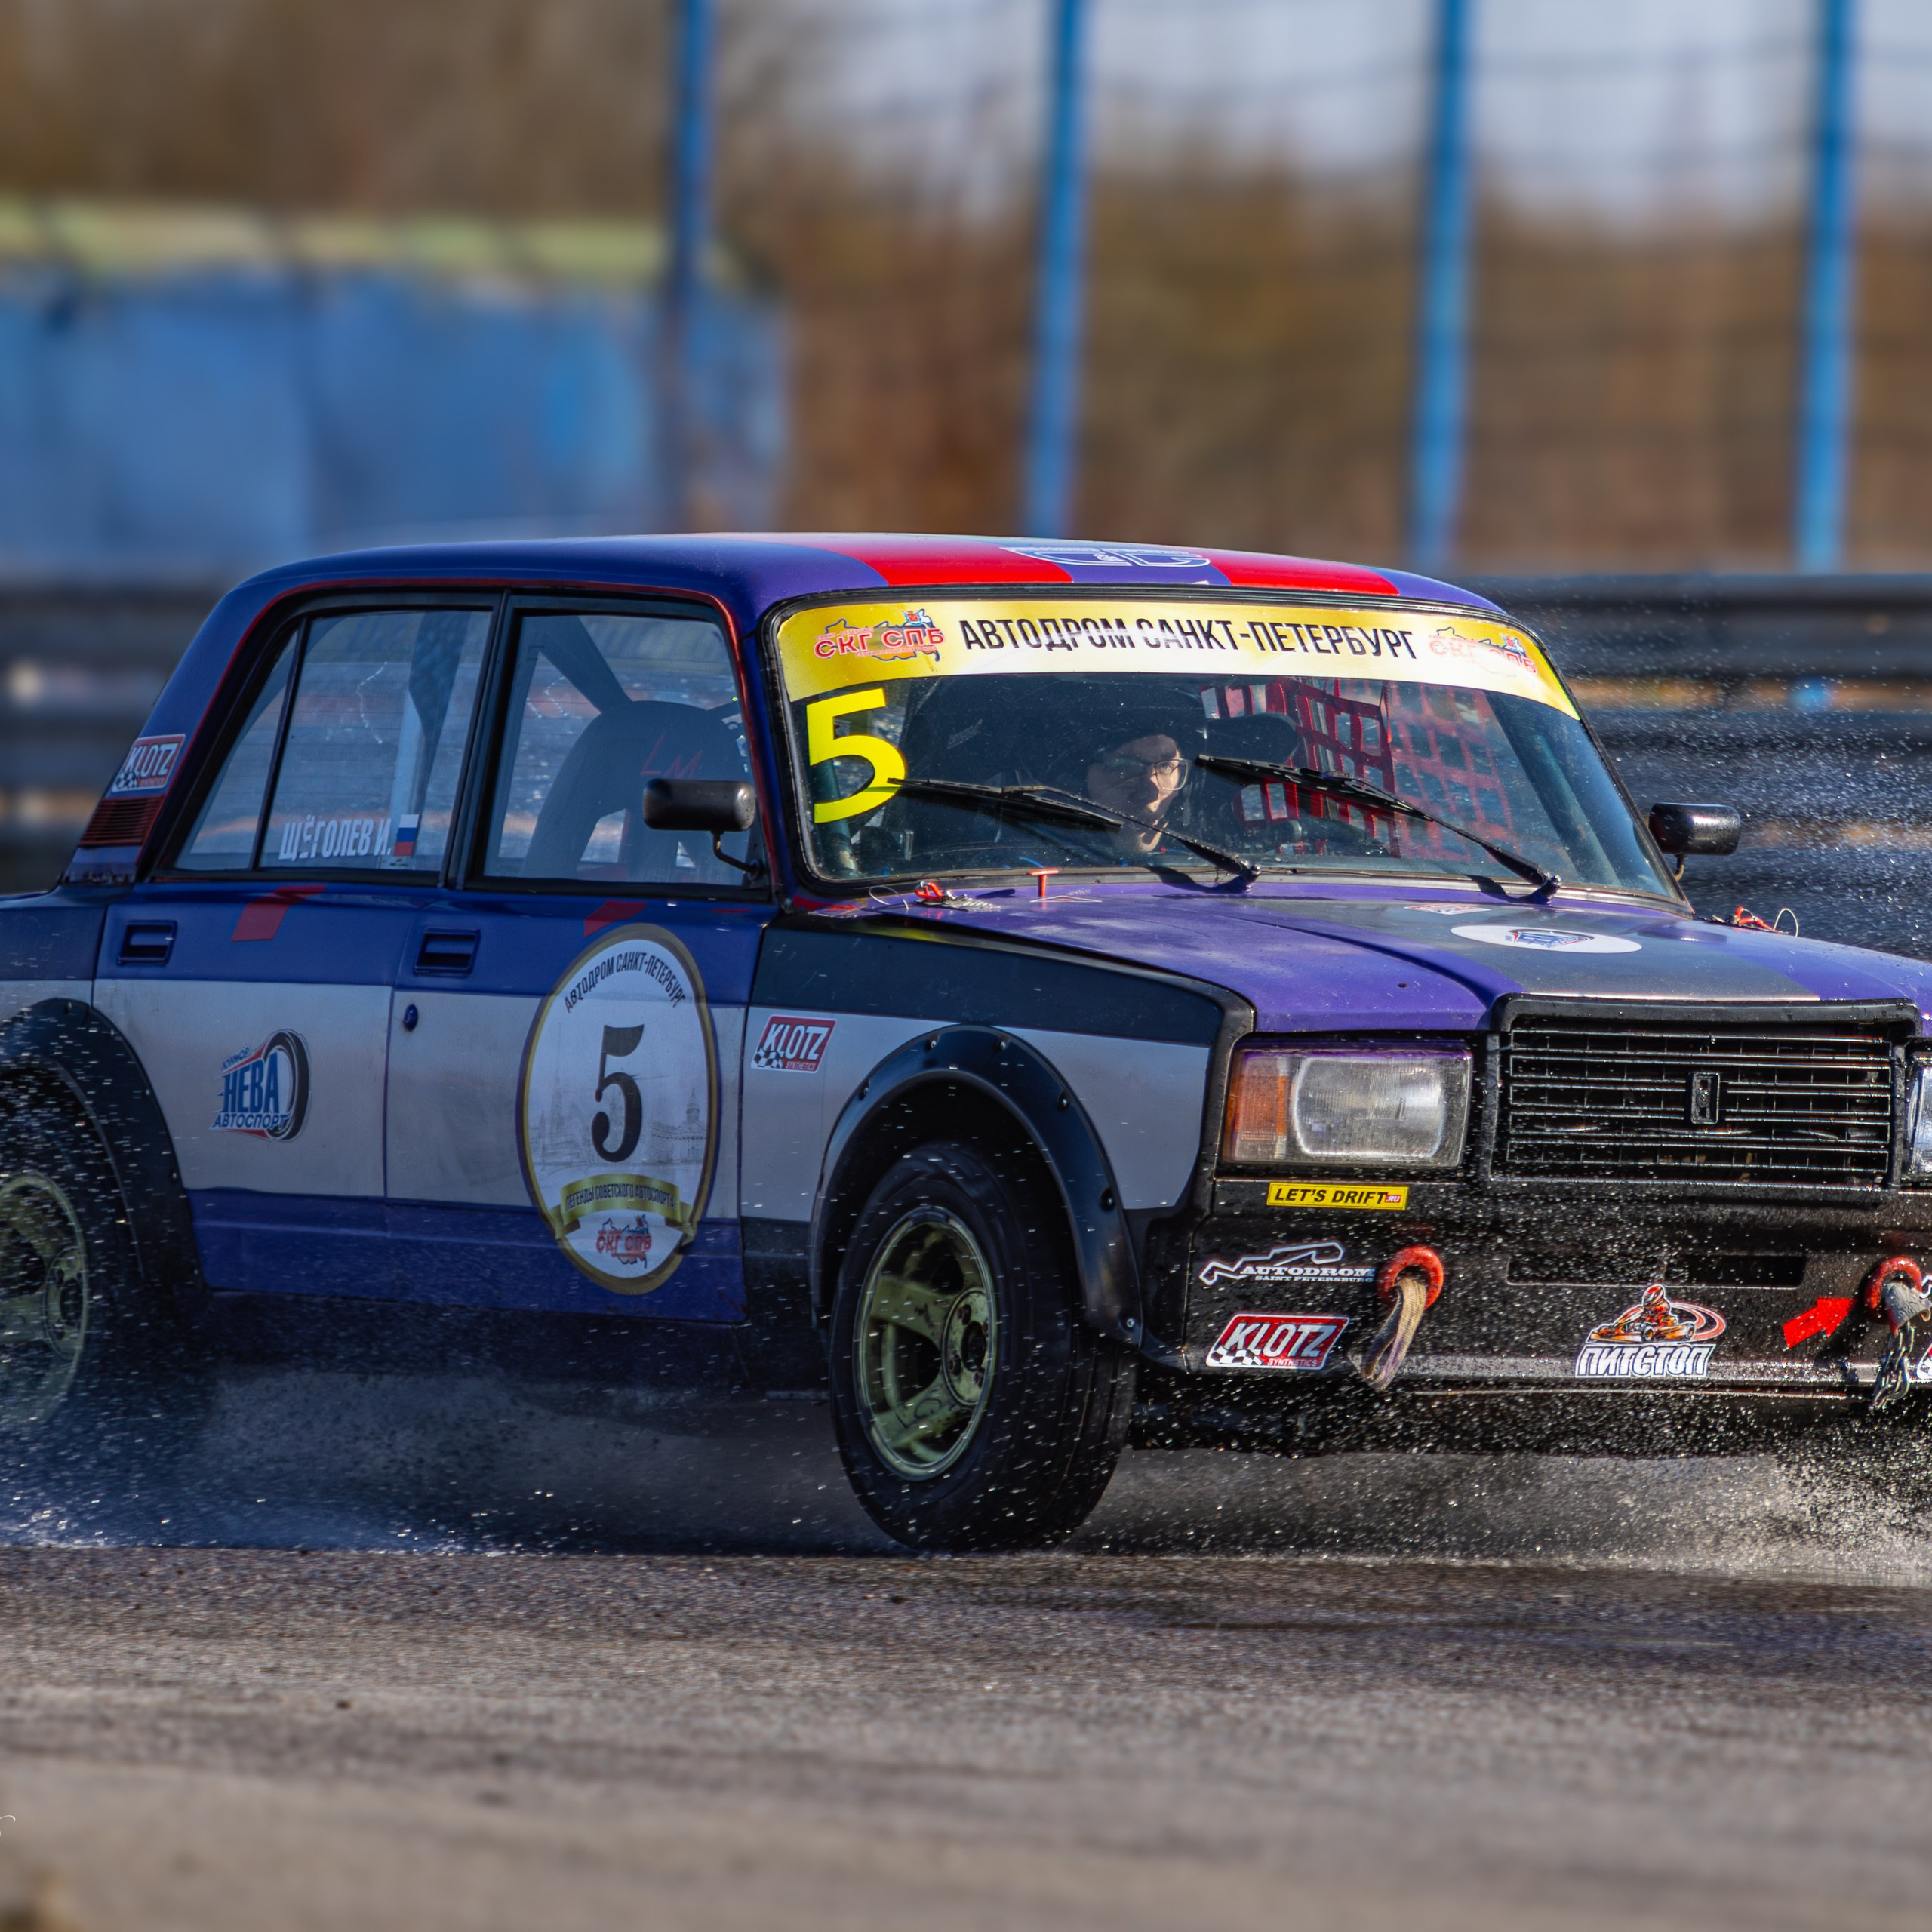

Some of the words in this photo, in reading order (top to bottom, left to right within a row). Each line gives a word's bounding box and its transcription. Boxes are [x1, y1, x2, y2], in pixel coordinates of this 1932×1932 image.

[814, 633, 872, 659] СКГ
[881, 628, 945, 649] СПБ
[959, 618, 1136, 652] АВТОДРОМ
[1137, 618, 1417, 659] САНКТ-ПЕТЕРБУРГ
[124, 743, 179, 778] KLOTZ
[806, 688, 907, 824] 5
[564, 956, 614, 1013] АВТОДРОМ
[616, 952, 686, 1008] САНКТ-ПЕТЕРБУРГ
[762, 1023, 830, 1060] KLOTZ
[222, 1051, 280, 1113] НЕВА
[591, 1024, 645, 1163] 5
[212, 1113, 291, 1129] АВТОСПОРТ
[566, 1186, 595, 1210] ЛЕГЕНДЫ
[595, 1183, 634, 1200] СОВЕТСКОГО
[635, 1184, 675, 1208] АВТОСПОРТА
[1274, 1187, 1327, 1203] LET'S
[1239, 1266, 1376, 1277] AUTODROM
[1223, 1321, 1338, 1357] KLOTZ
[1267, 1358, 1318, 1367] SYNTHETICS
[1576, 1343, 1713, 1377] ПИТСТОП
